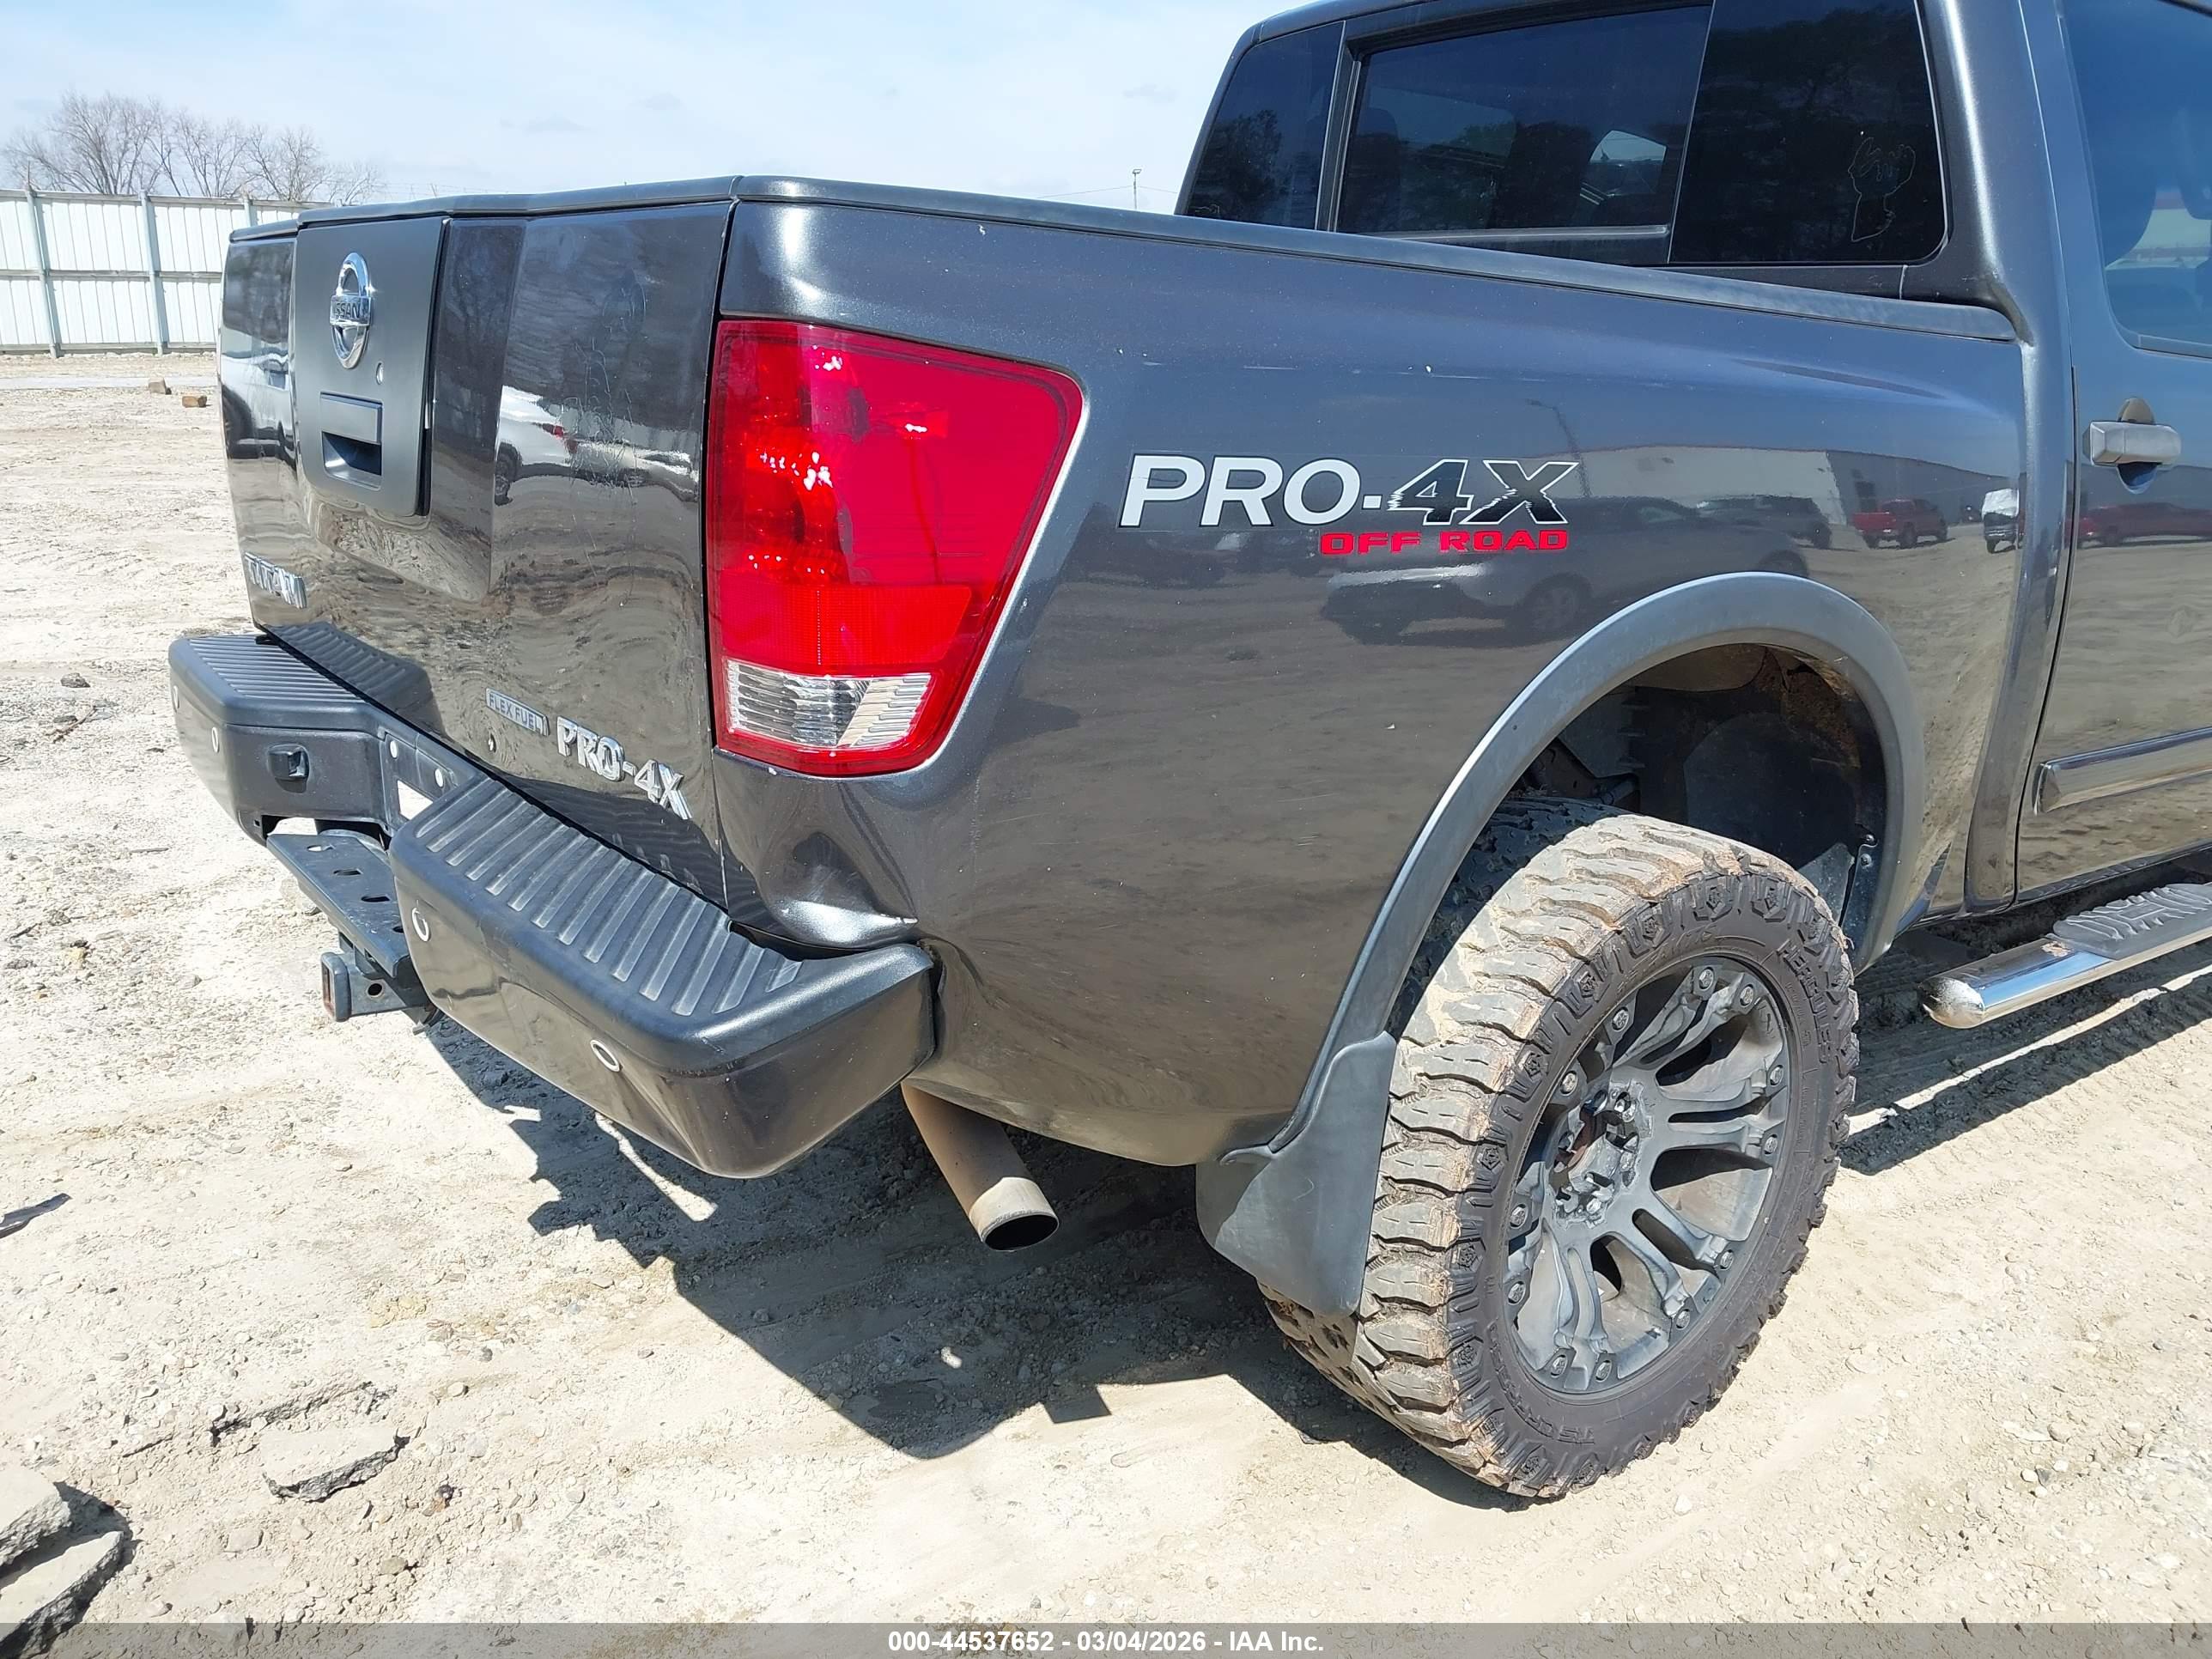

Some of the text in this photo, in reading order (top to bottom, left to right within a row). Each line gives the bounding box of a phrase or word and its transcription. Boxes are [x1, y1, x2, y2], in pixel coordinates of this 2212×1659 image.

[1118, 453, 1579, 528] PRO-4X
[1320, 530, 1569, 556] OFF ROAD
[488, 691, 544, 732] FLEX FUEL
[556, 715, 692, 820] PRO-4X
